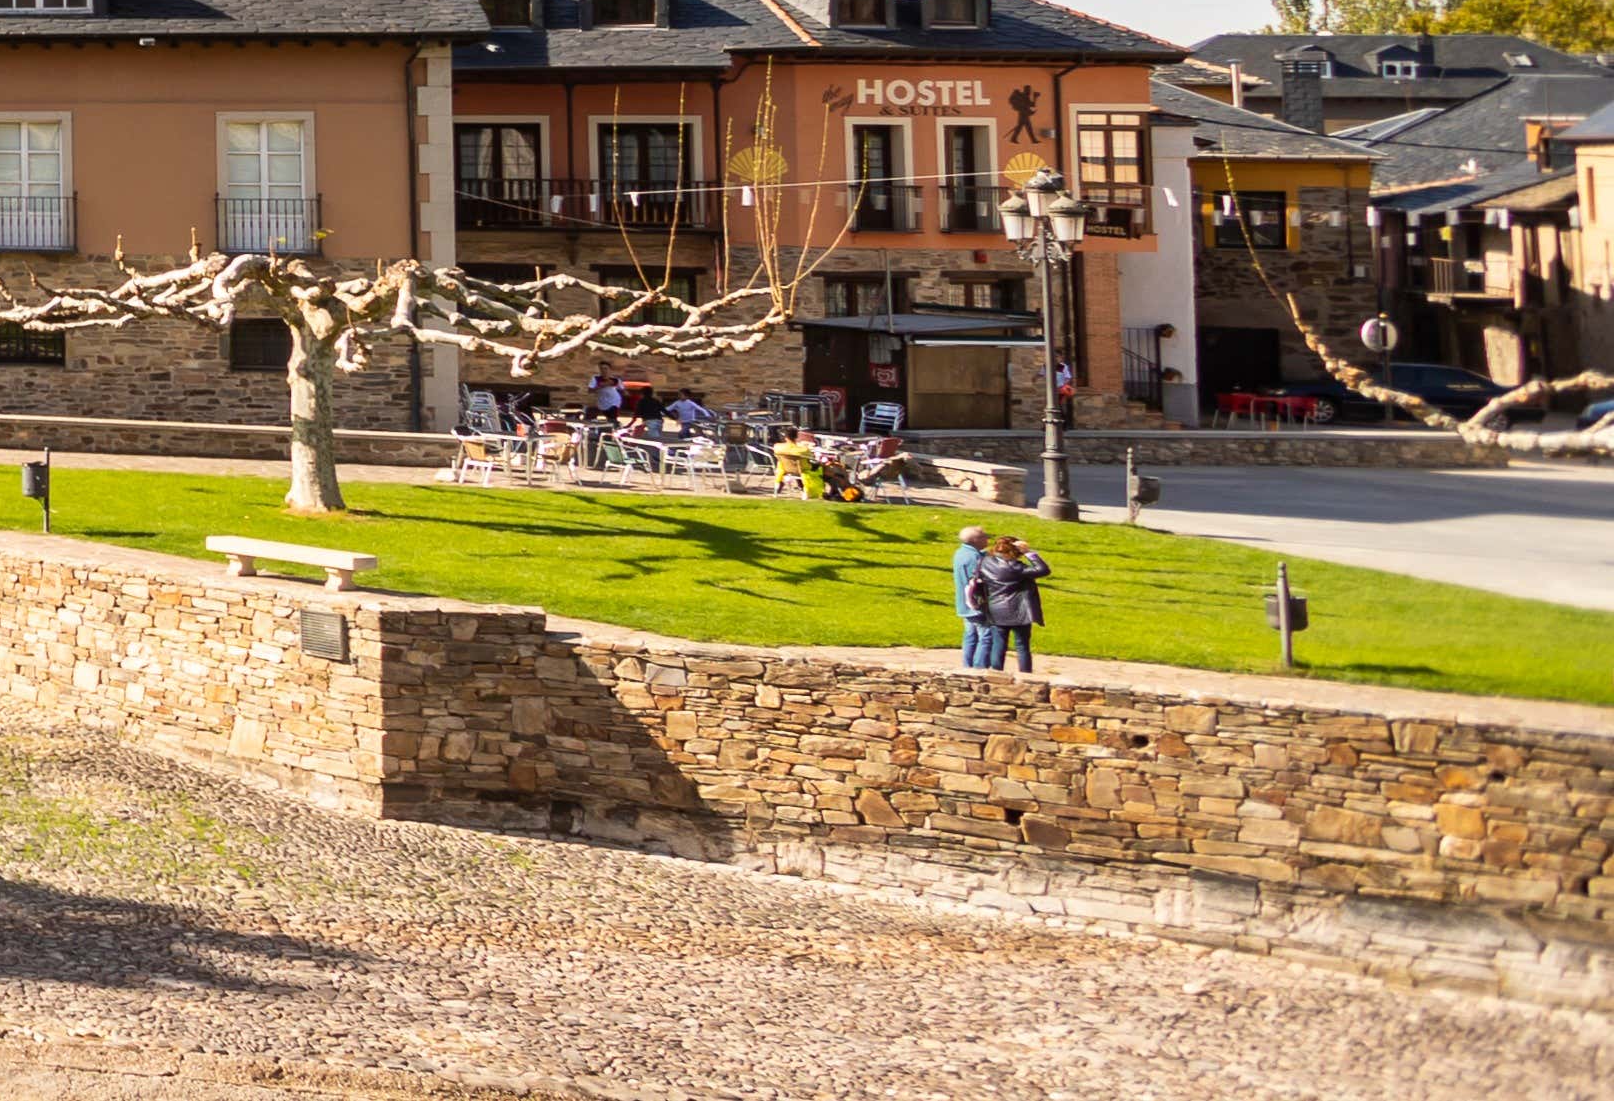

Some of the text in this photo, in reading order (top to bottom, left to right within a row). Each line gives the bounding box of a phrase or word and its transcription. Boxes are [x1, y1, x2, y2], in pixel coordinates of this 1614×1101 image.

[857, 78, 991, 107] HOSTEL
[878, 105, 962, 117] & SUITES
